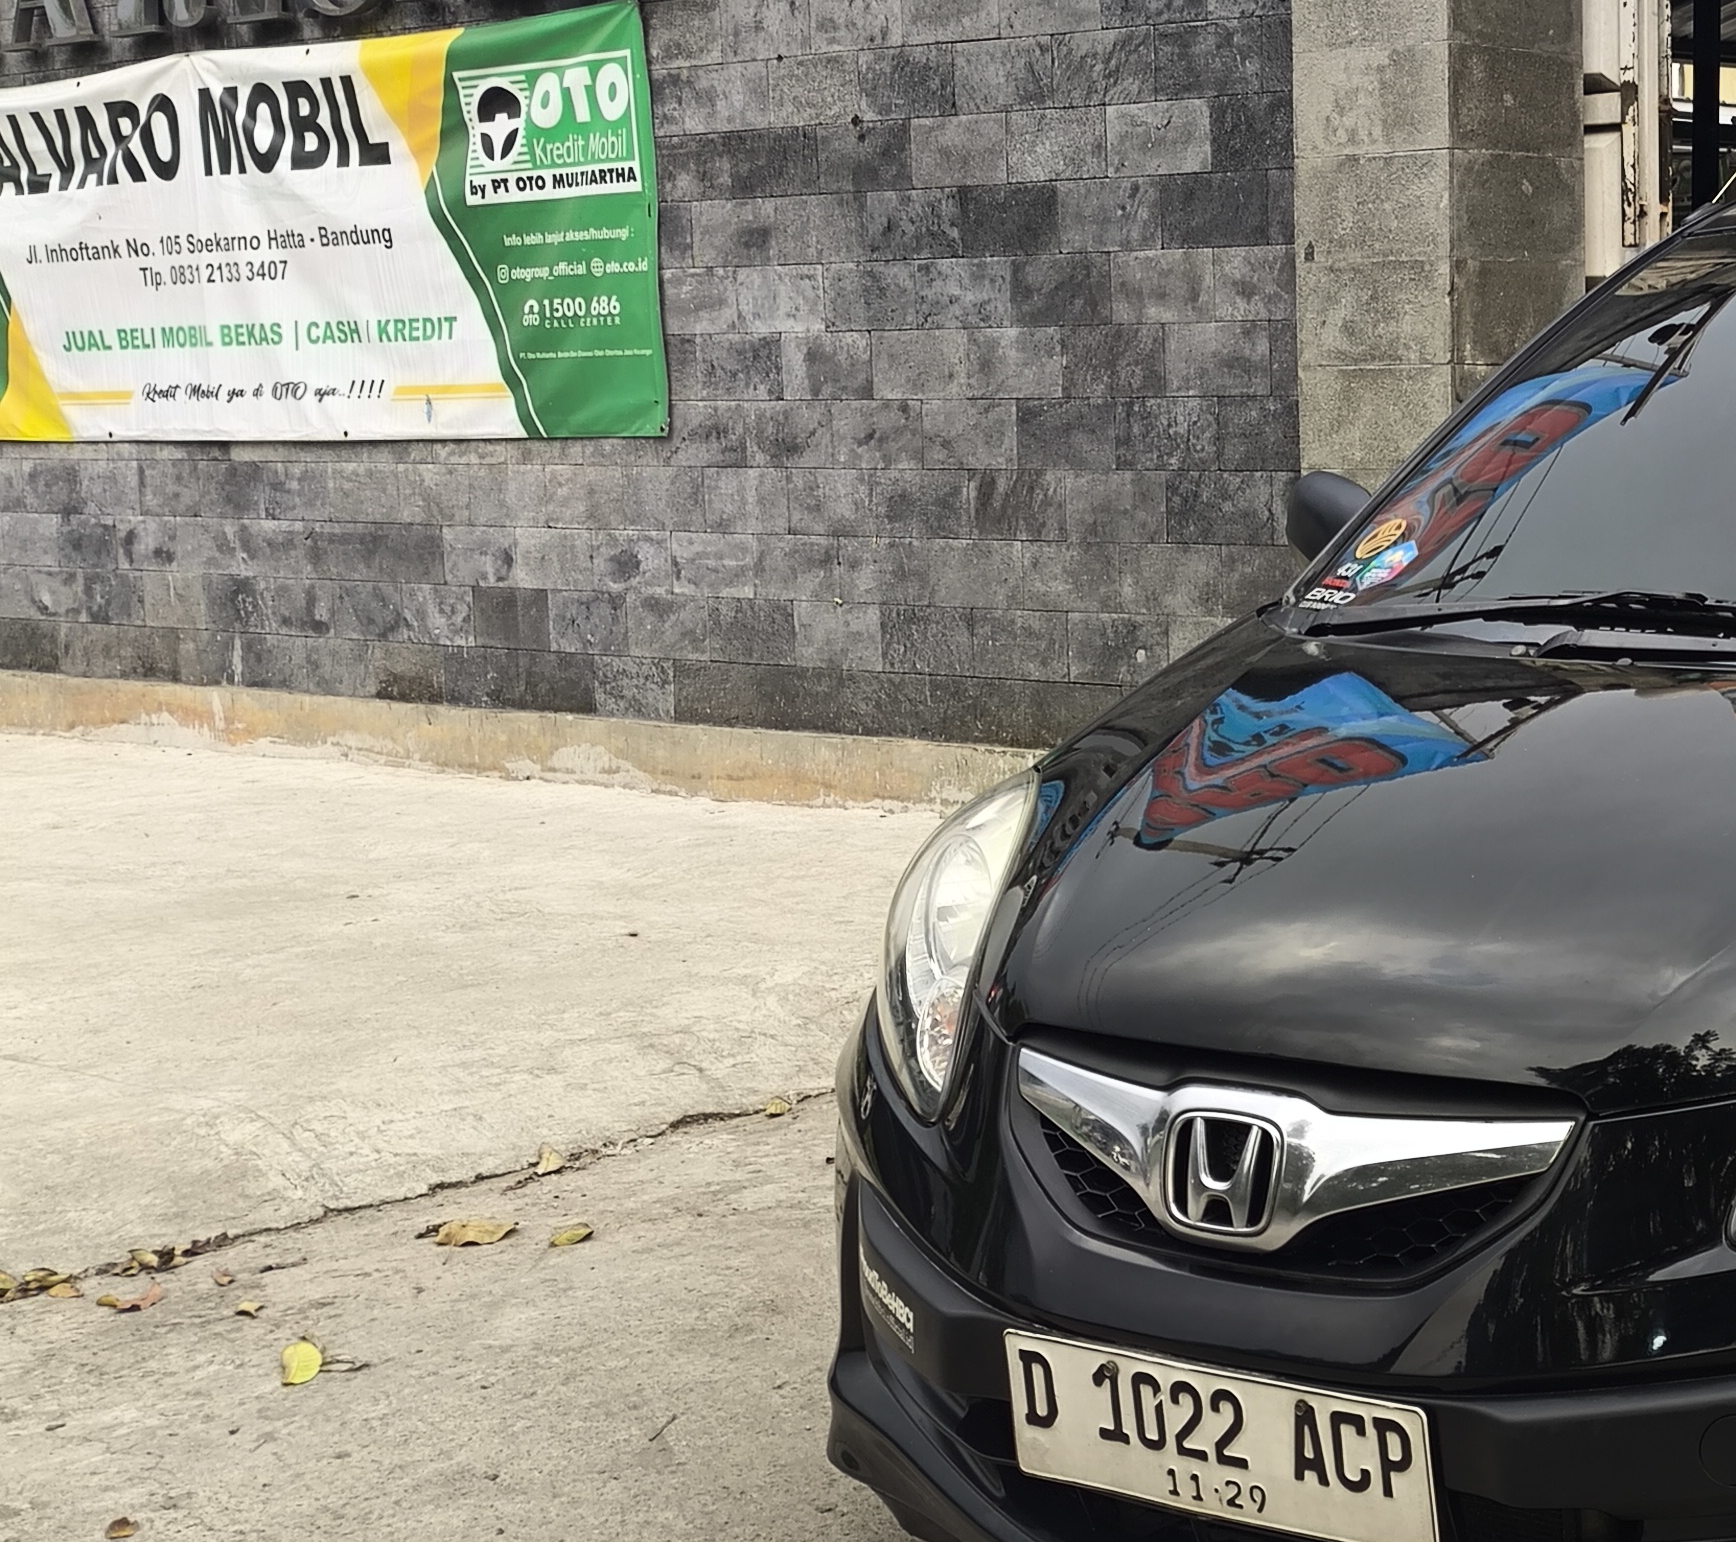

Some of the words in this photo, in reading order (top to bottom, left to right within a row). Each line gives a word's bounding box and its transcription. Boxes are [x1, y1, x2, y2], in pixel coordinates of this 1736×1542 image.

[529, 62, 630, 130] OTO
[0, 91, 181, 197] ALVARO
[197, 74, 392, 178] MOBIL
[533, 134, 585, 165] Kredit
[586, 128, 627, 161] Mobil
[469, 179, 486, 200] by
[491, 178, 509, 194] PT
[515, 175, 546, 192] OTO
[552, 166, 638, 190] MULTIARTHA
[45, 241, 122, 264] Inhoftank
[126, 237, 155, 259] No.
[159, 235, 182, 256] 105
[186, 232, 261, 255] Soekarno
[268, 228, 306, 251] Hatta
[318, 224, 394, 250] Bandung
[503, 234, 523, 247] Info
[523, 233, 544, 246] lebih
[170, 263, 202, 285] 0831
[206, 261, 242, 283] 2133
[245, 260, 289, 282] 3407
[511, 260, 588, 282] otogroup_official
[605, 257, 649, 274] oto.co.id
[542, 296, 587, 319] 1500
[590, 295, 622, 317] 686
[522, 313, 540, 327] OTO
[544, 317, 575, 329] CALL
[579, 316, 622, 328] CENTER
[62, 329, 113, 353] JUAL
[117, 327, 157, 350] BELI
[161, 325, 214, 348] MOBIL
[220, 322, 284, 347] BEKAS
[306, 319, 363, 345] CASH
[376, 316, 458, 343] KREDIT
[142, 382, 182, 402] Kredit
[184, 382, 222, 401] Mobil
[226, 387, 248, 403] ya
[252, 383, 265, 398] di
[271, 381, 308, 401] OTO
[1304, 587, 1357, 605] BRIO
[1018, 1349, 1058, 1429] D
[1092, 1361, 1249, 1470] 1022
[1294, 1399, 1413, 1498] ACP
